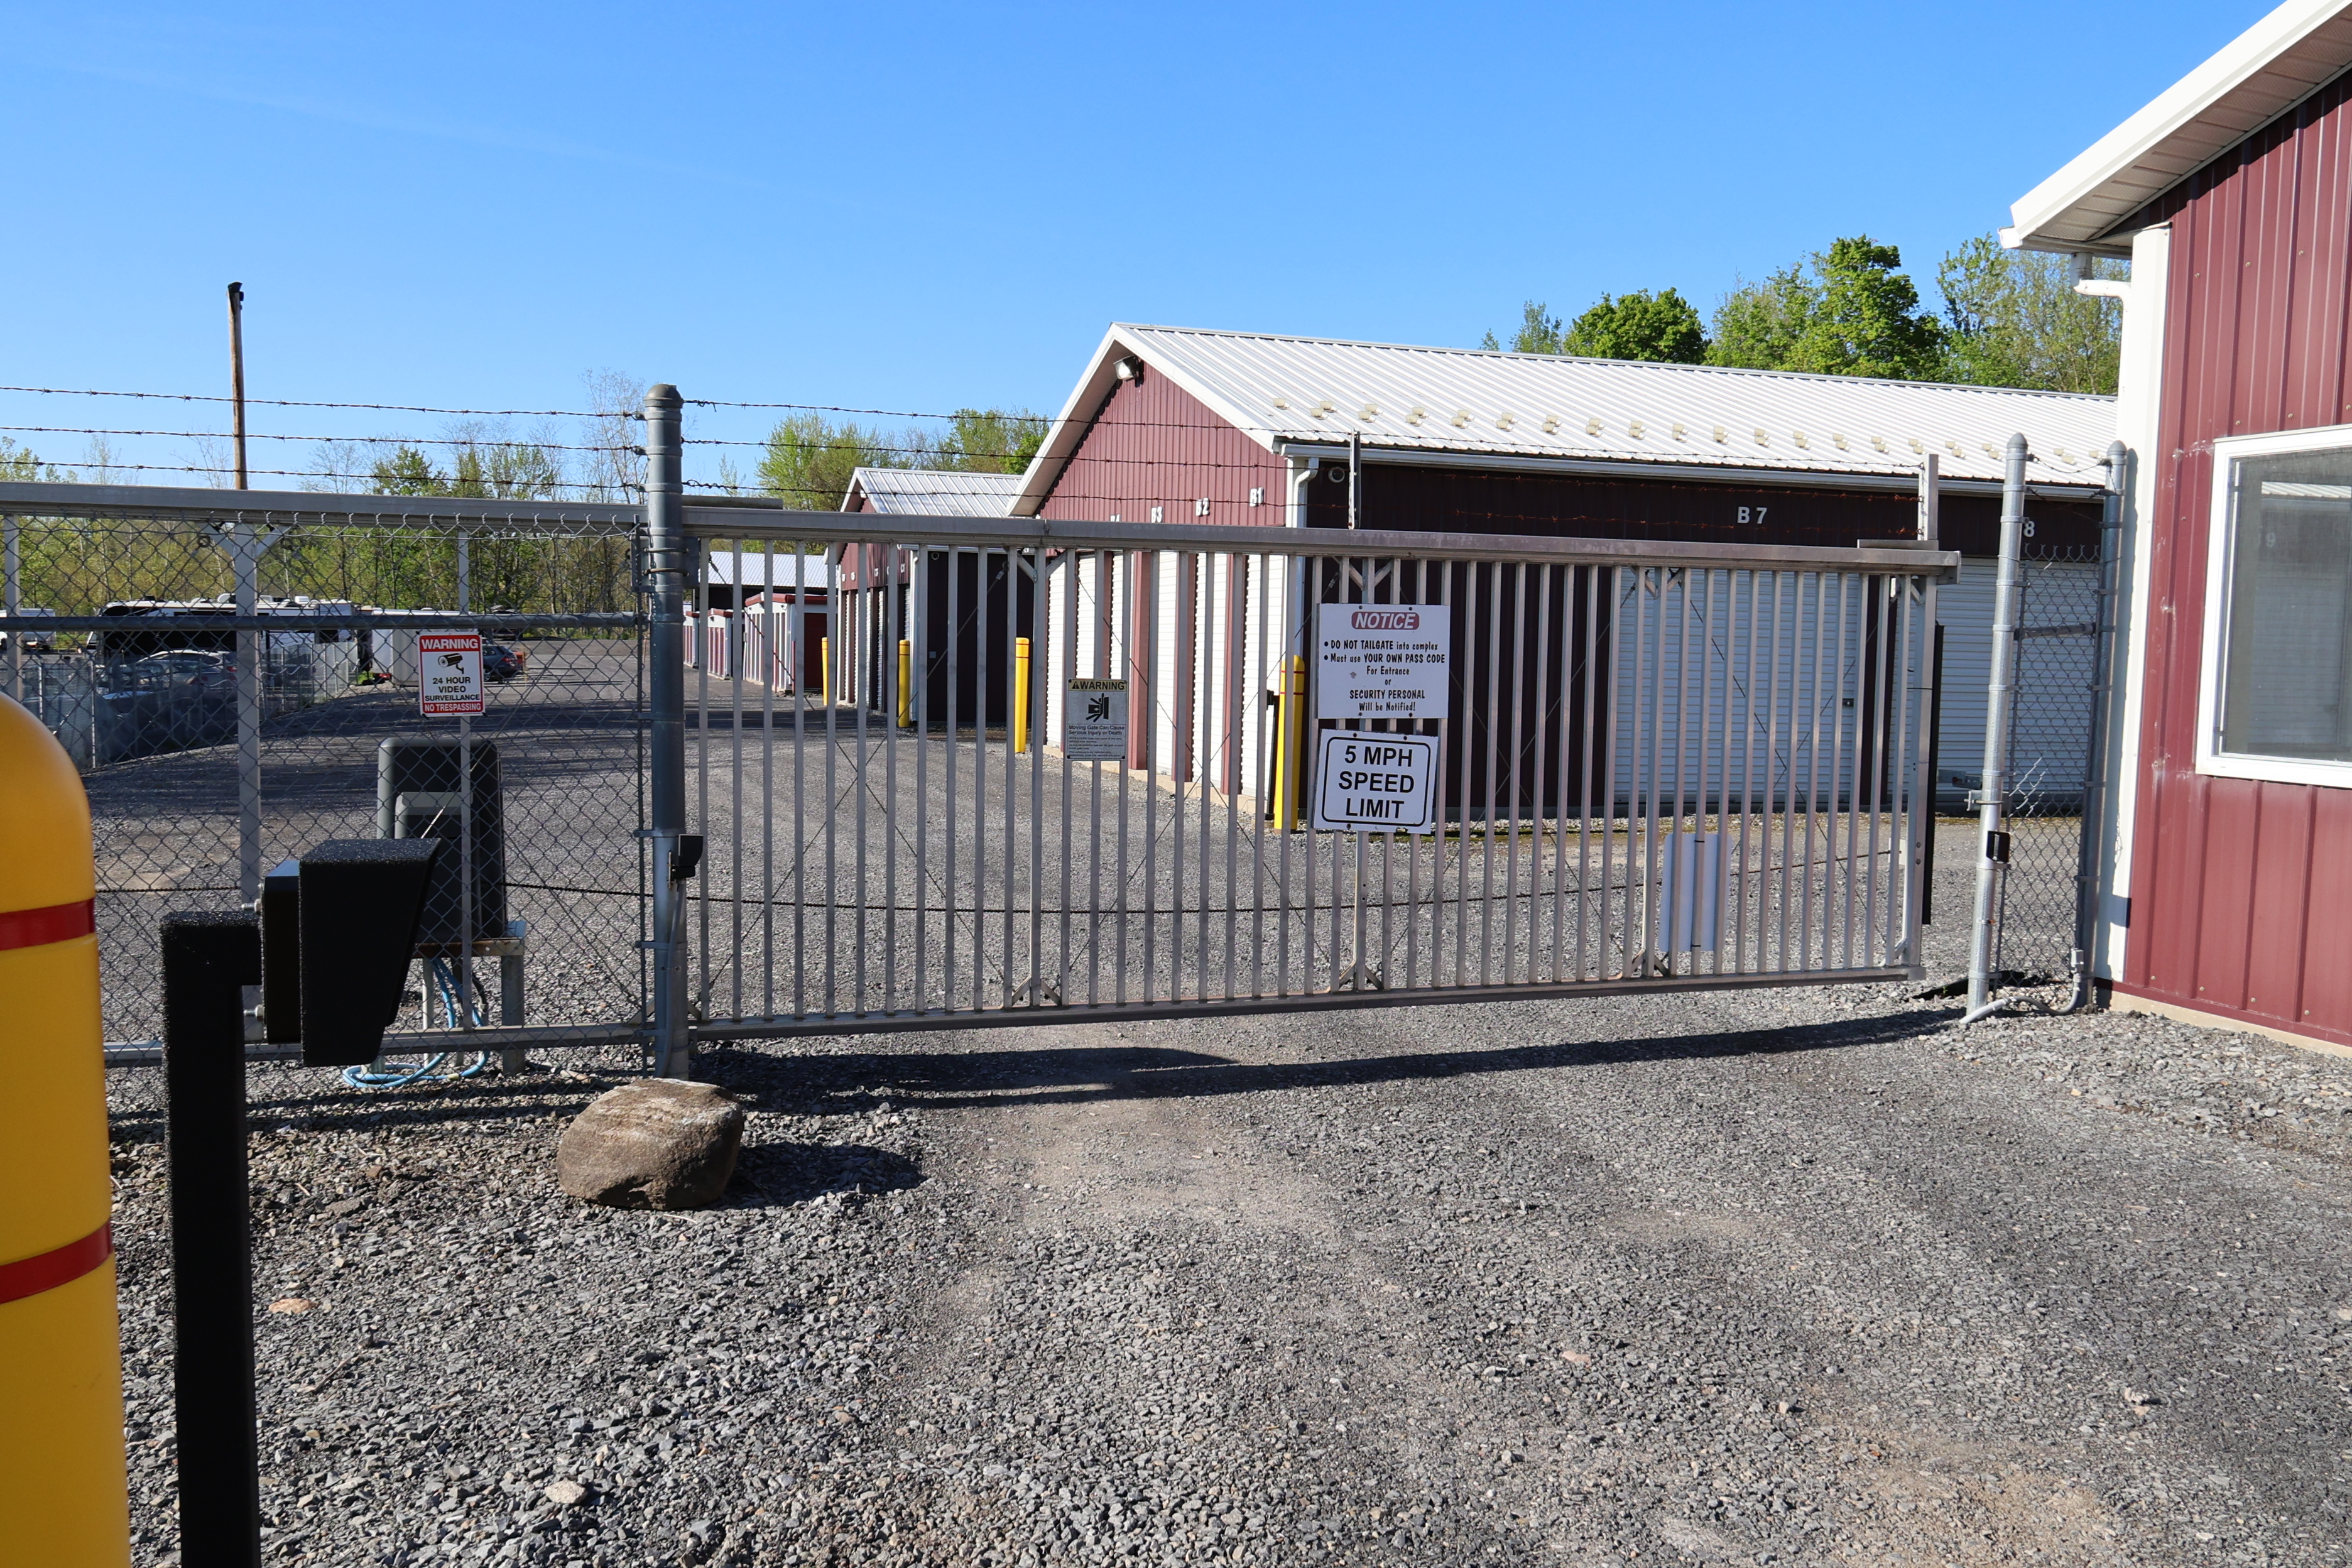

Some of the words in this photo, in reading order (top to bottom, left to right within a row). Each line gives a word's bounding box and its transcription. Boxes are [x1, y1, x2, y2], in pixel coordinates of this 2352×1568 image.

[1250, 487, 1264, 507] B1
[1195, 498, 1210, 516] B2
[1151, 506, 1163, 523] B3
[1355, 612, 1416, 629] NOTICE
[421, 638, 479, 650] WARNING
[1331, 640, 1341, 650] DO
[1344, 640, 1358, 650] NOT
[1361, 640, 1393, 650] TAILGATE
[1396, 641, 1410, 650] into
[1412, 641, 1438, 652] complex
[1331, 653, 1347, 663] Must
[1364, 653, 1383, 663] YOUR
[1386, 653, 1403, 663] OWN
[1405, 653, 1424, 663] PASS
[1427, 654, 1445, 663] CODE
[1366, 665, 1378, 675] For
[1380, 665, 1410, 675] Entrance
[1080, 681, 1124, 690] WARNING
[1349, 689, 1385, 699] SECURITY
[1388, 690, 1425, 699] PERSONAL
[436, 703, 481, 712] TRESPASSING
[1359, 702, 1373, 711] Will
[1375, 702, 1383, 711] be
[1386, 701, 1416, 711] Notified!
[1344, 745, 1356, 764] 5
[1364, 746, 1413, 767] MPH
[1338, 771, 1415, 793] SPEED
[1346, 798, 1405, 819] LIMIT
